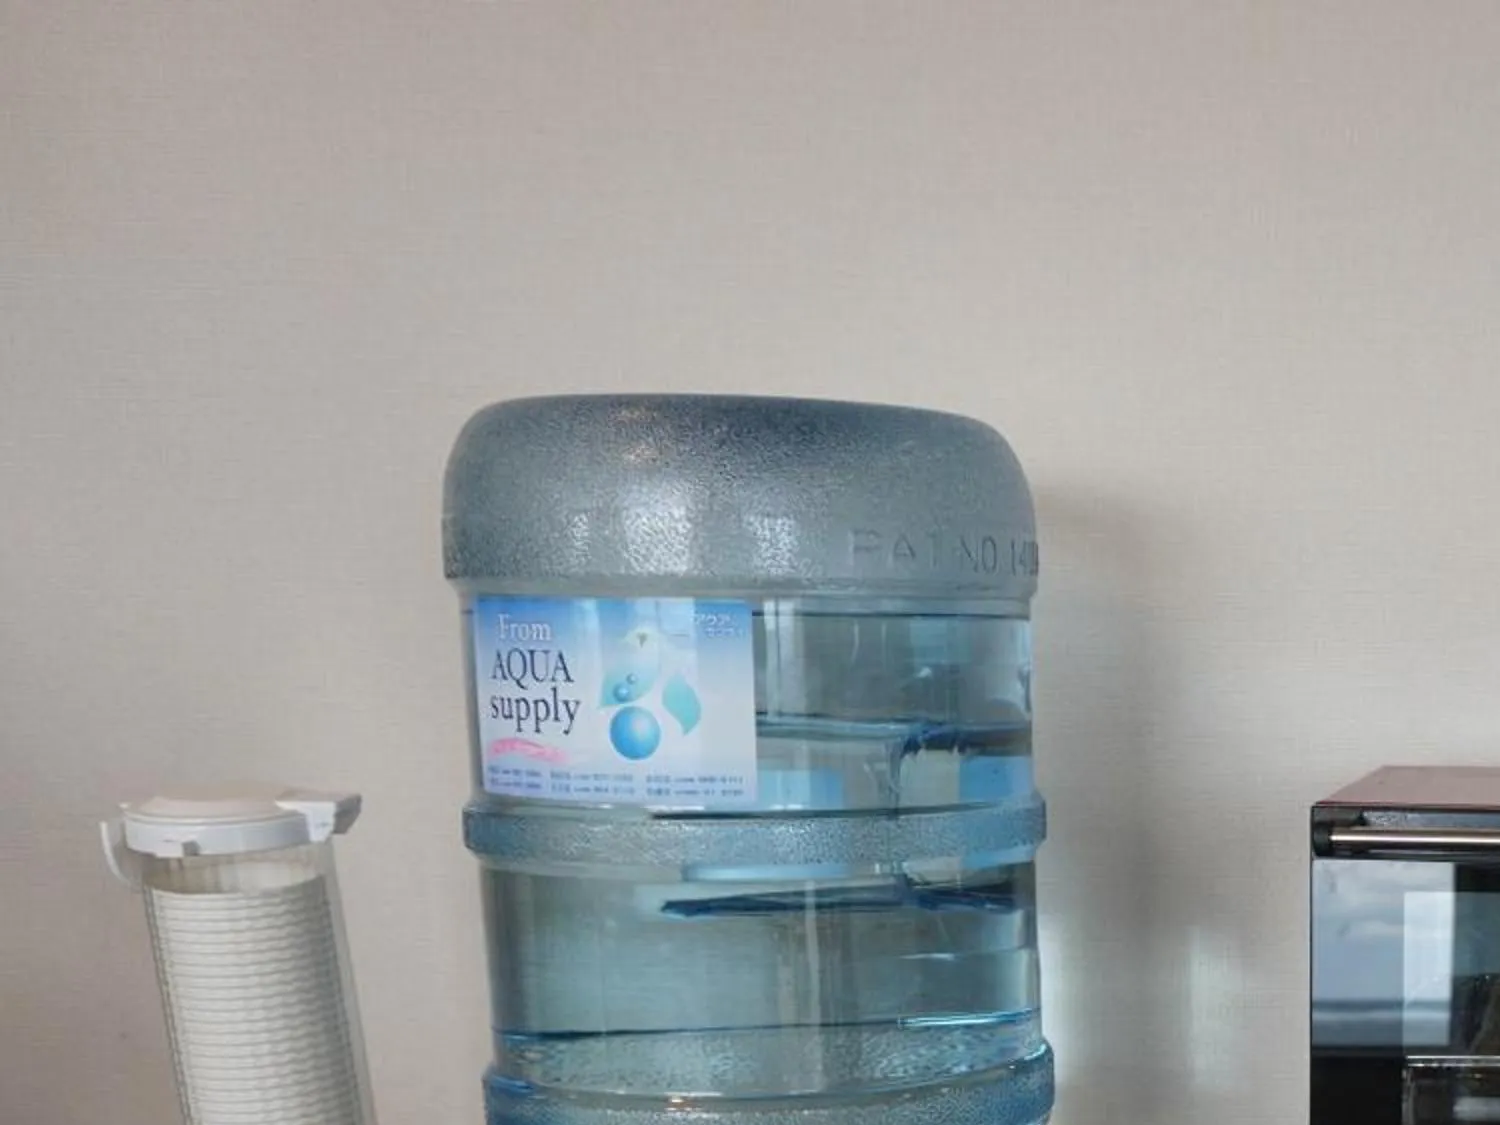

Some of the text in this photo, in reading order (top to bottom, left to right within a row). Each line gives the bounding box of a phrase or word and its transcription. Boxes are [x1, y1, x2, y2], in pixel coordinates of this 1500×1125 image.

[498, 612, 551, 642] From
[491, 647, 576, 690] AQUA
[489, 686, 581, 736] supply
